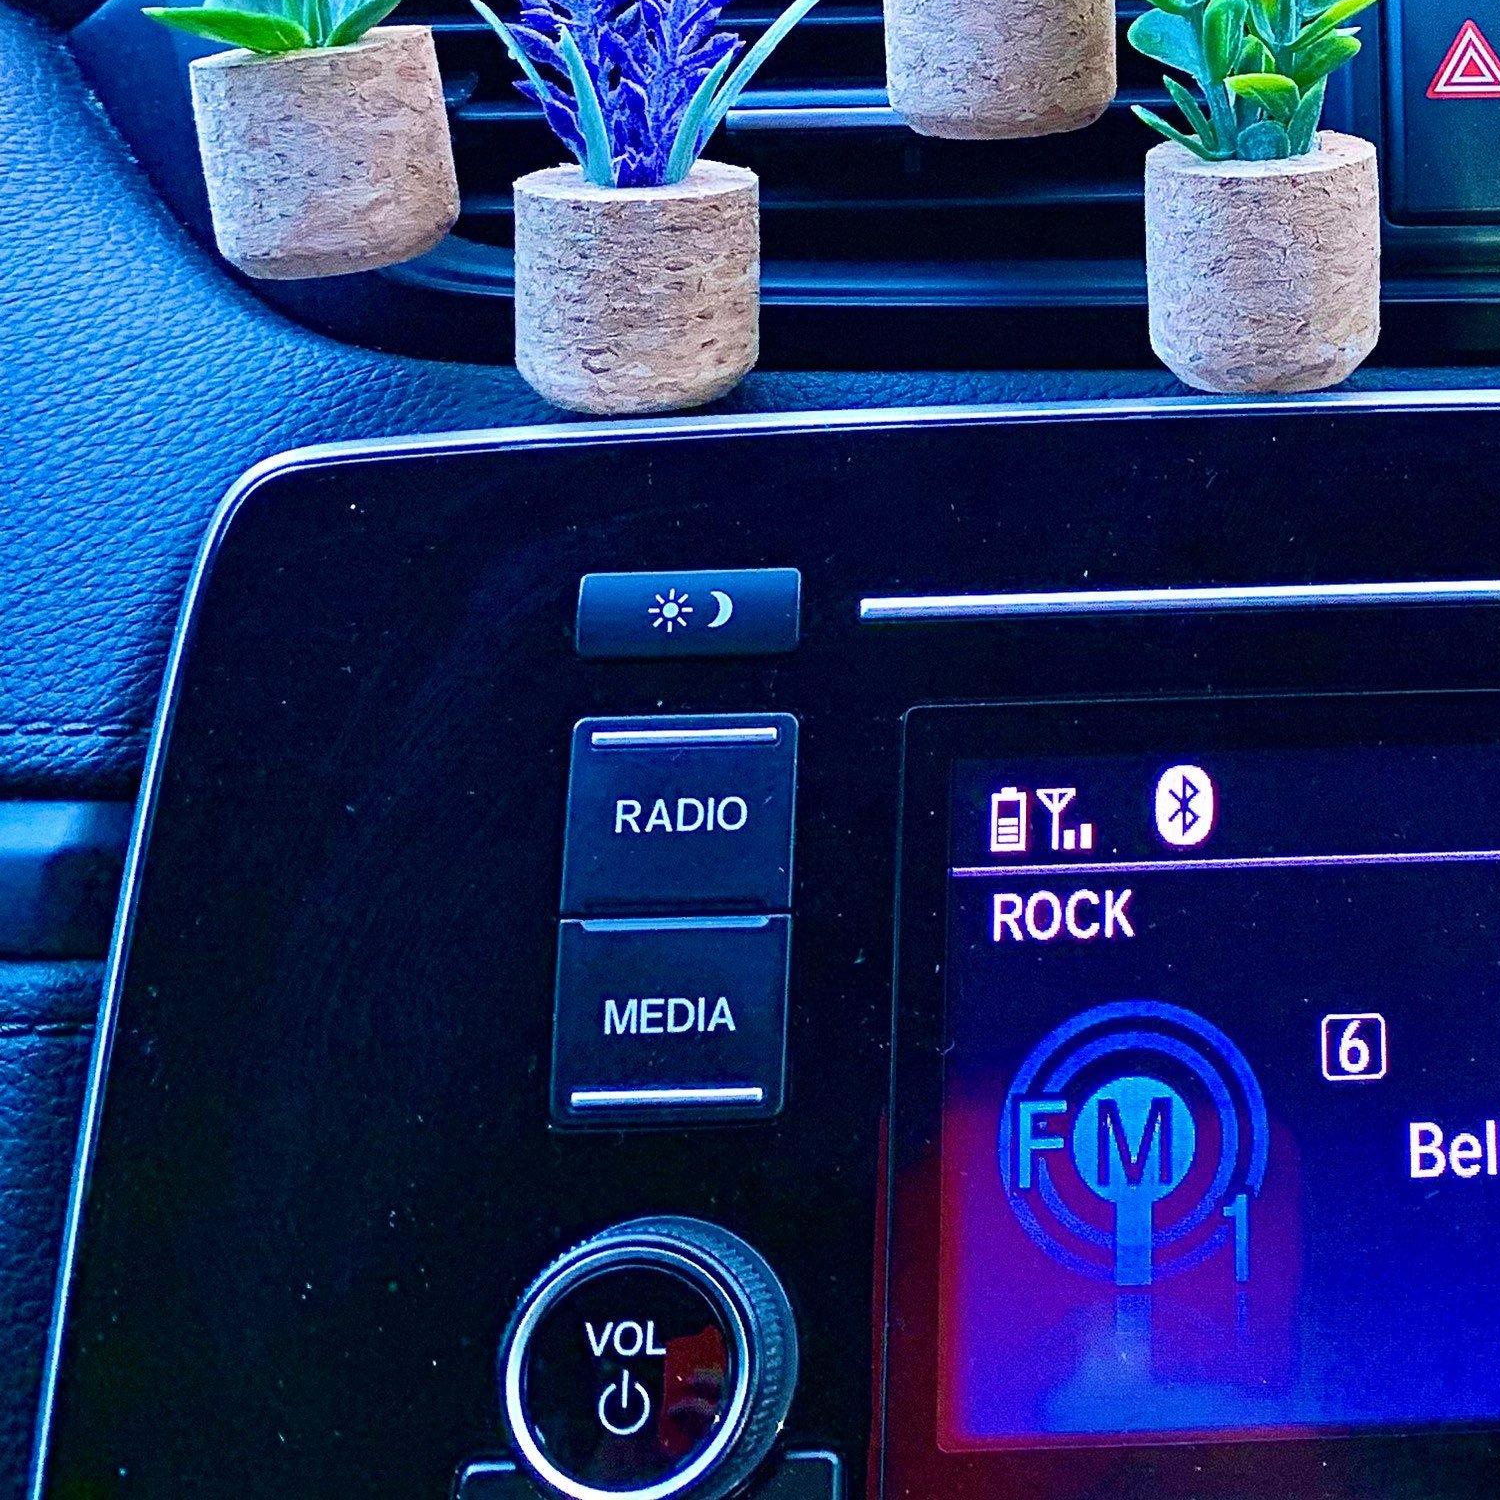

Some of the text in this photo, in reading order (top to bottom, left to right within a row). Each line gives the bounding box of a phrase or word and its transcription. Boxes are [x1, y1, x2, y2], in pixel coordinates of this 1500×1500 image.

[614, 796, 748, 834] RADIO
[993, 888, 1136, 943] ROCK
[604, 996, 736, 1035] MEDIA
[1339, 1021, 1370, 1074] 6
[585, 1320, 667, 1357] VOL
